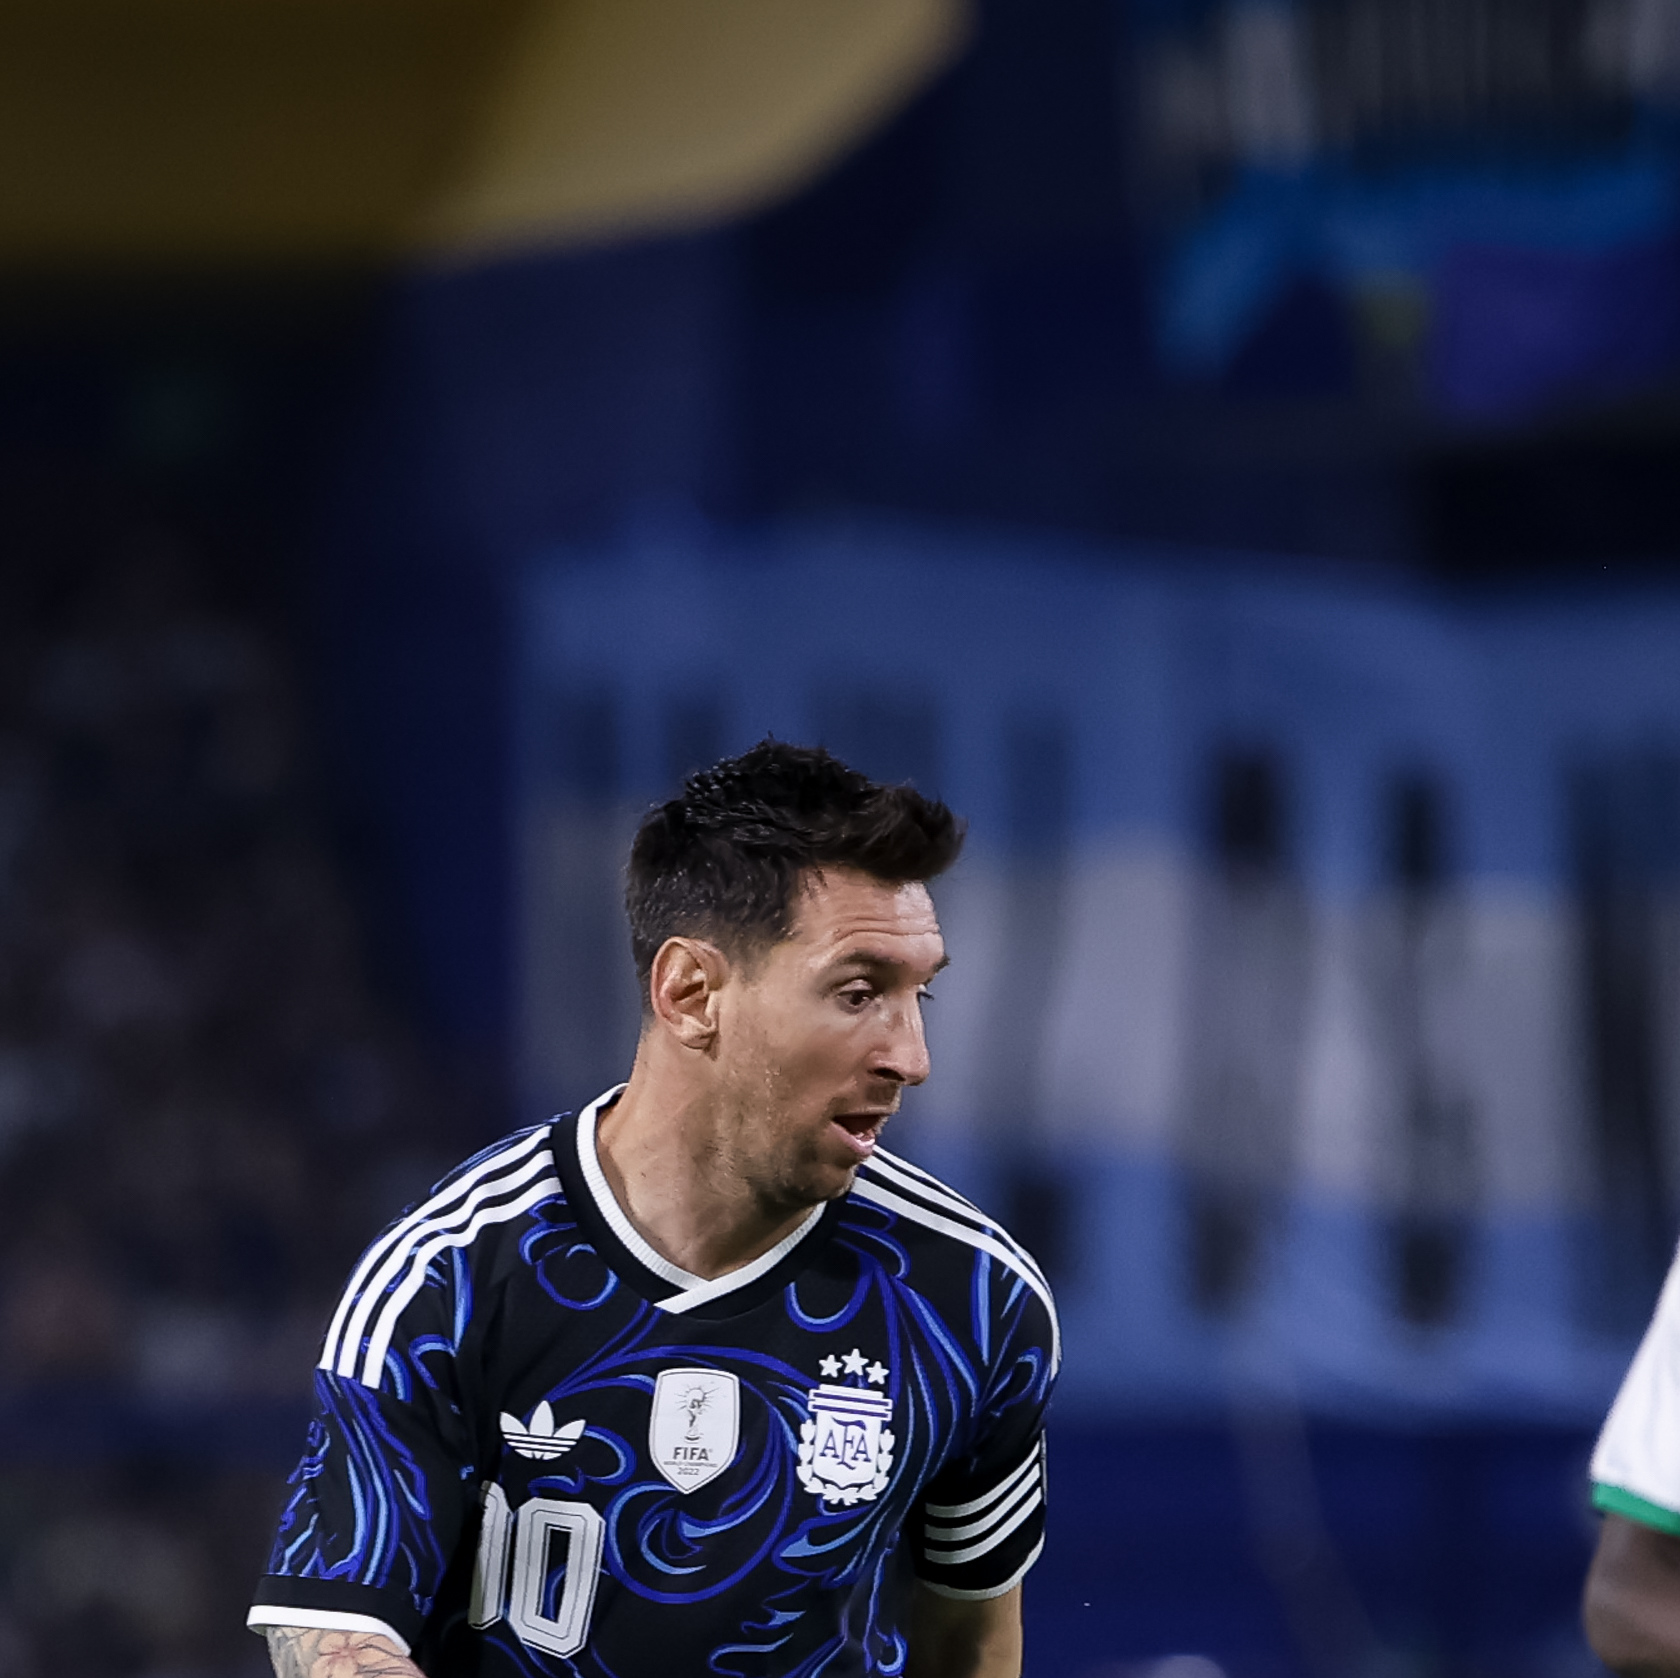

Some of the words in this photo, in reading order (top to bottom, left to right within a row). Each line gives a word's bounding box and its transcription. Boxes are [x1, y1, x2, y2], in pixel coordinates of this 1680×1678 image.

[672, 1446, 710, 1461] FIFA
[819, 1415, 872, 1470] AFA
[468, 1479, 607, 1660] 10
